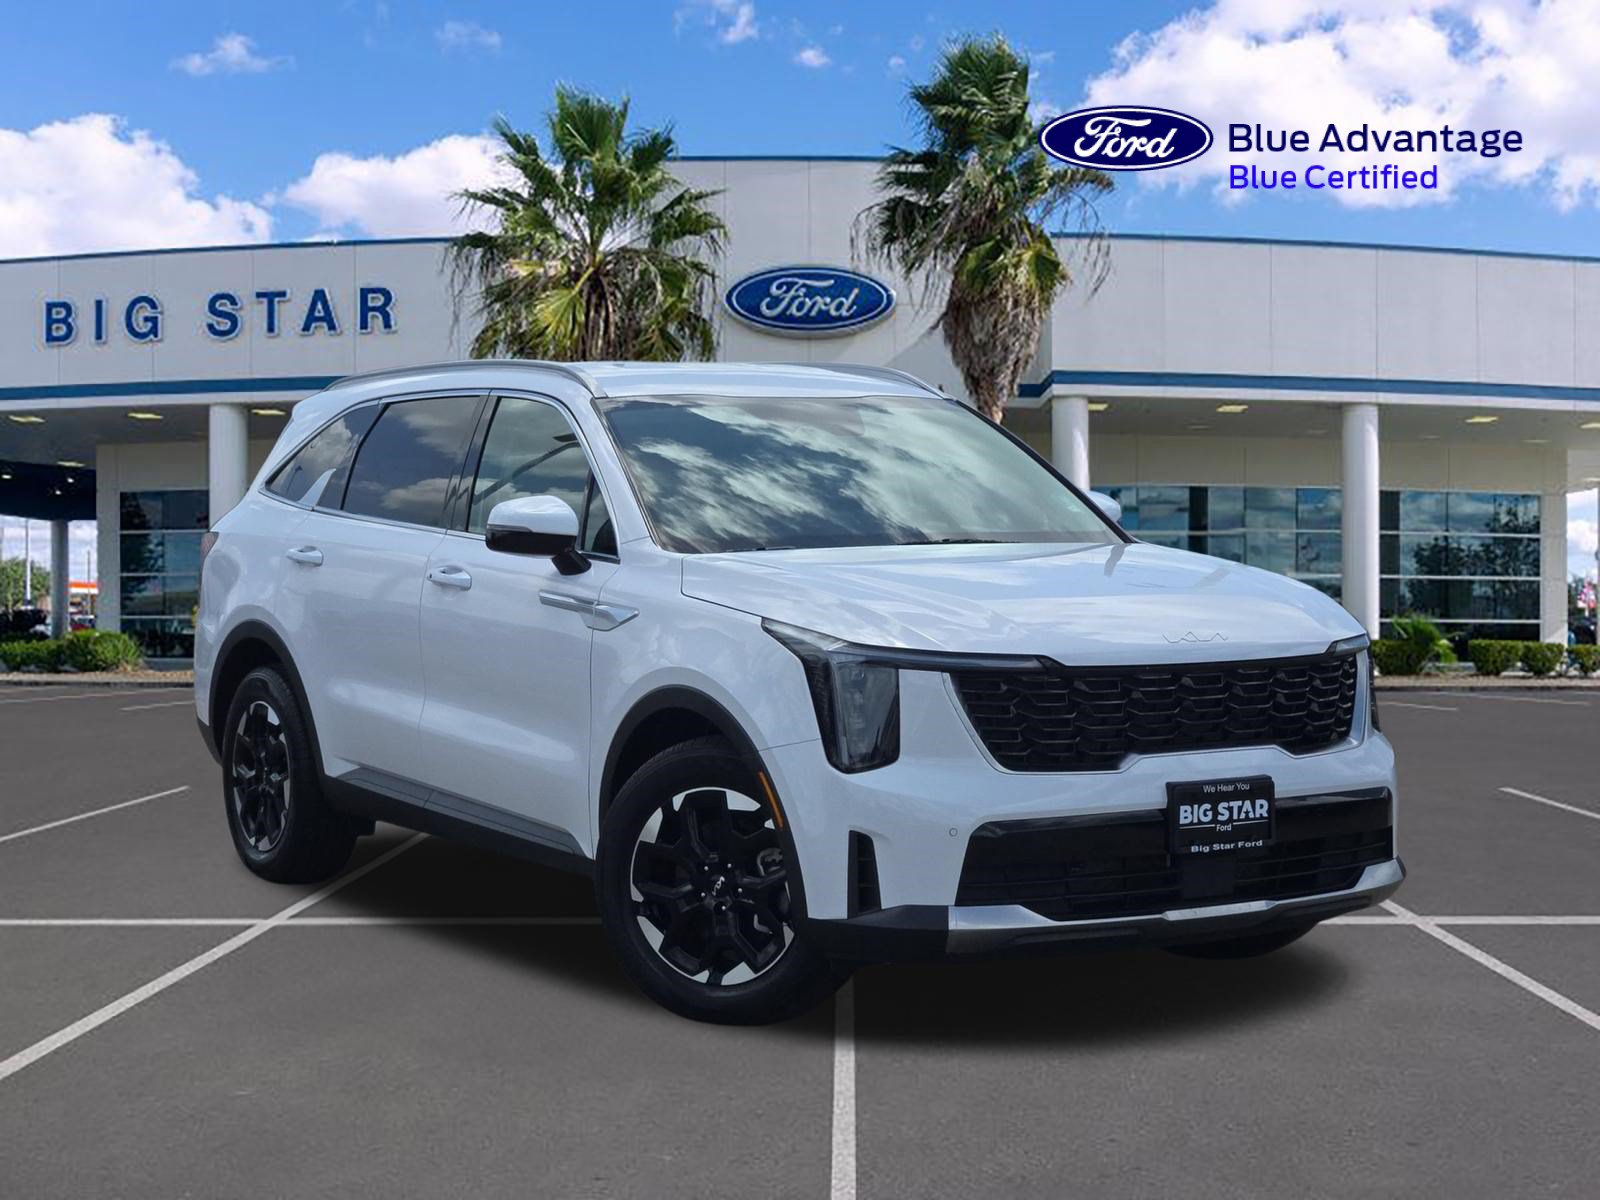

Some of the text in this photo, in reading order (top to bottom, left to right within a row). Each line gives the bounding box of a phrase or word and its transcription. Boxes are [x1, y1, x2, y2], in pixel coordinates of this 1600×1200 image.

[760, 277, 860, 317] Ford
[43, 286, 399, 346] BIG STAR
[1203, 782, 1250, 793] We Hear You
[1179, 799, 1269, 825] BIG STAR
[1216, 823, 1232, 832] Ford
[1191, 839, 1263, 853] Big Star Ford
